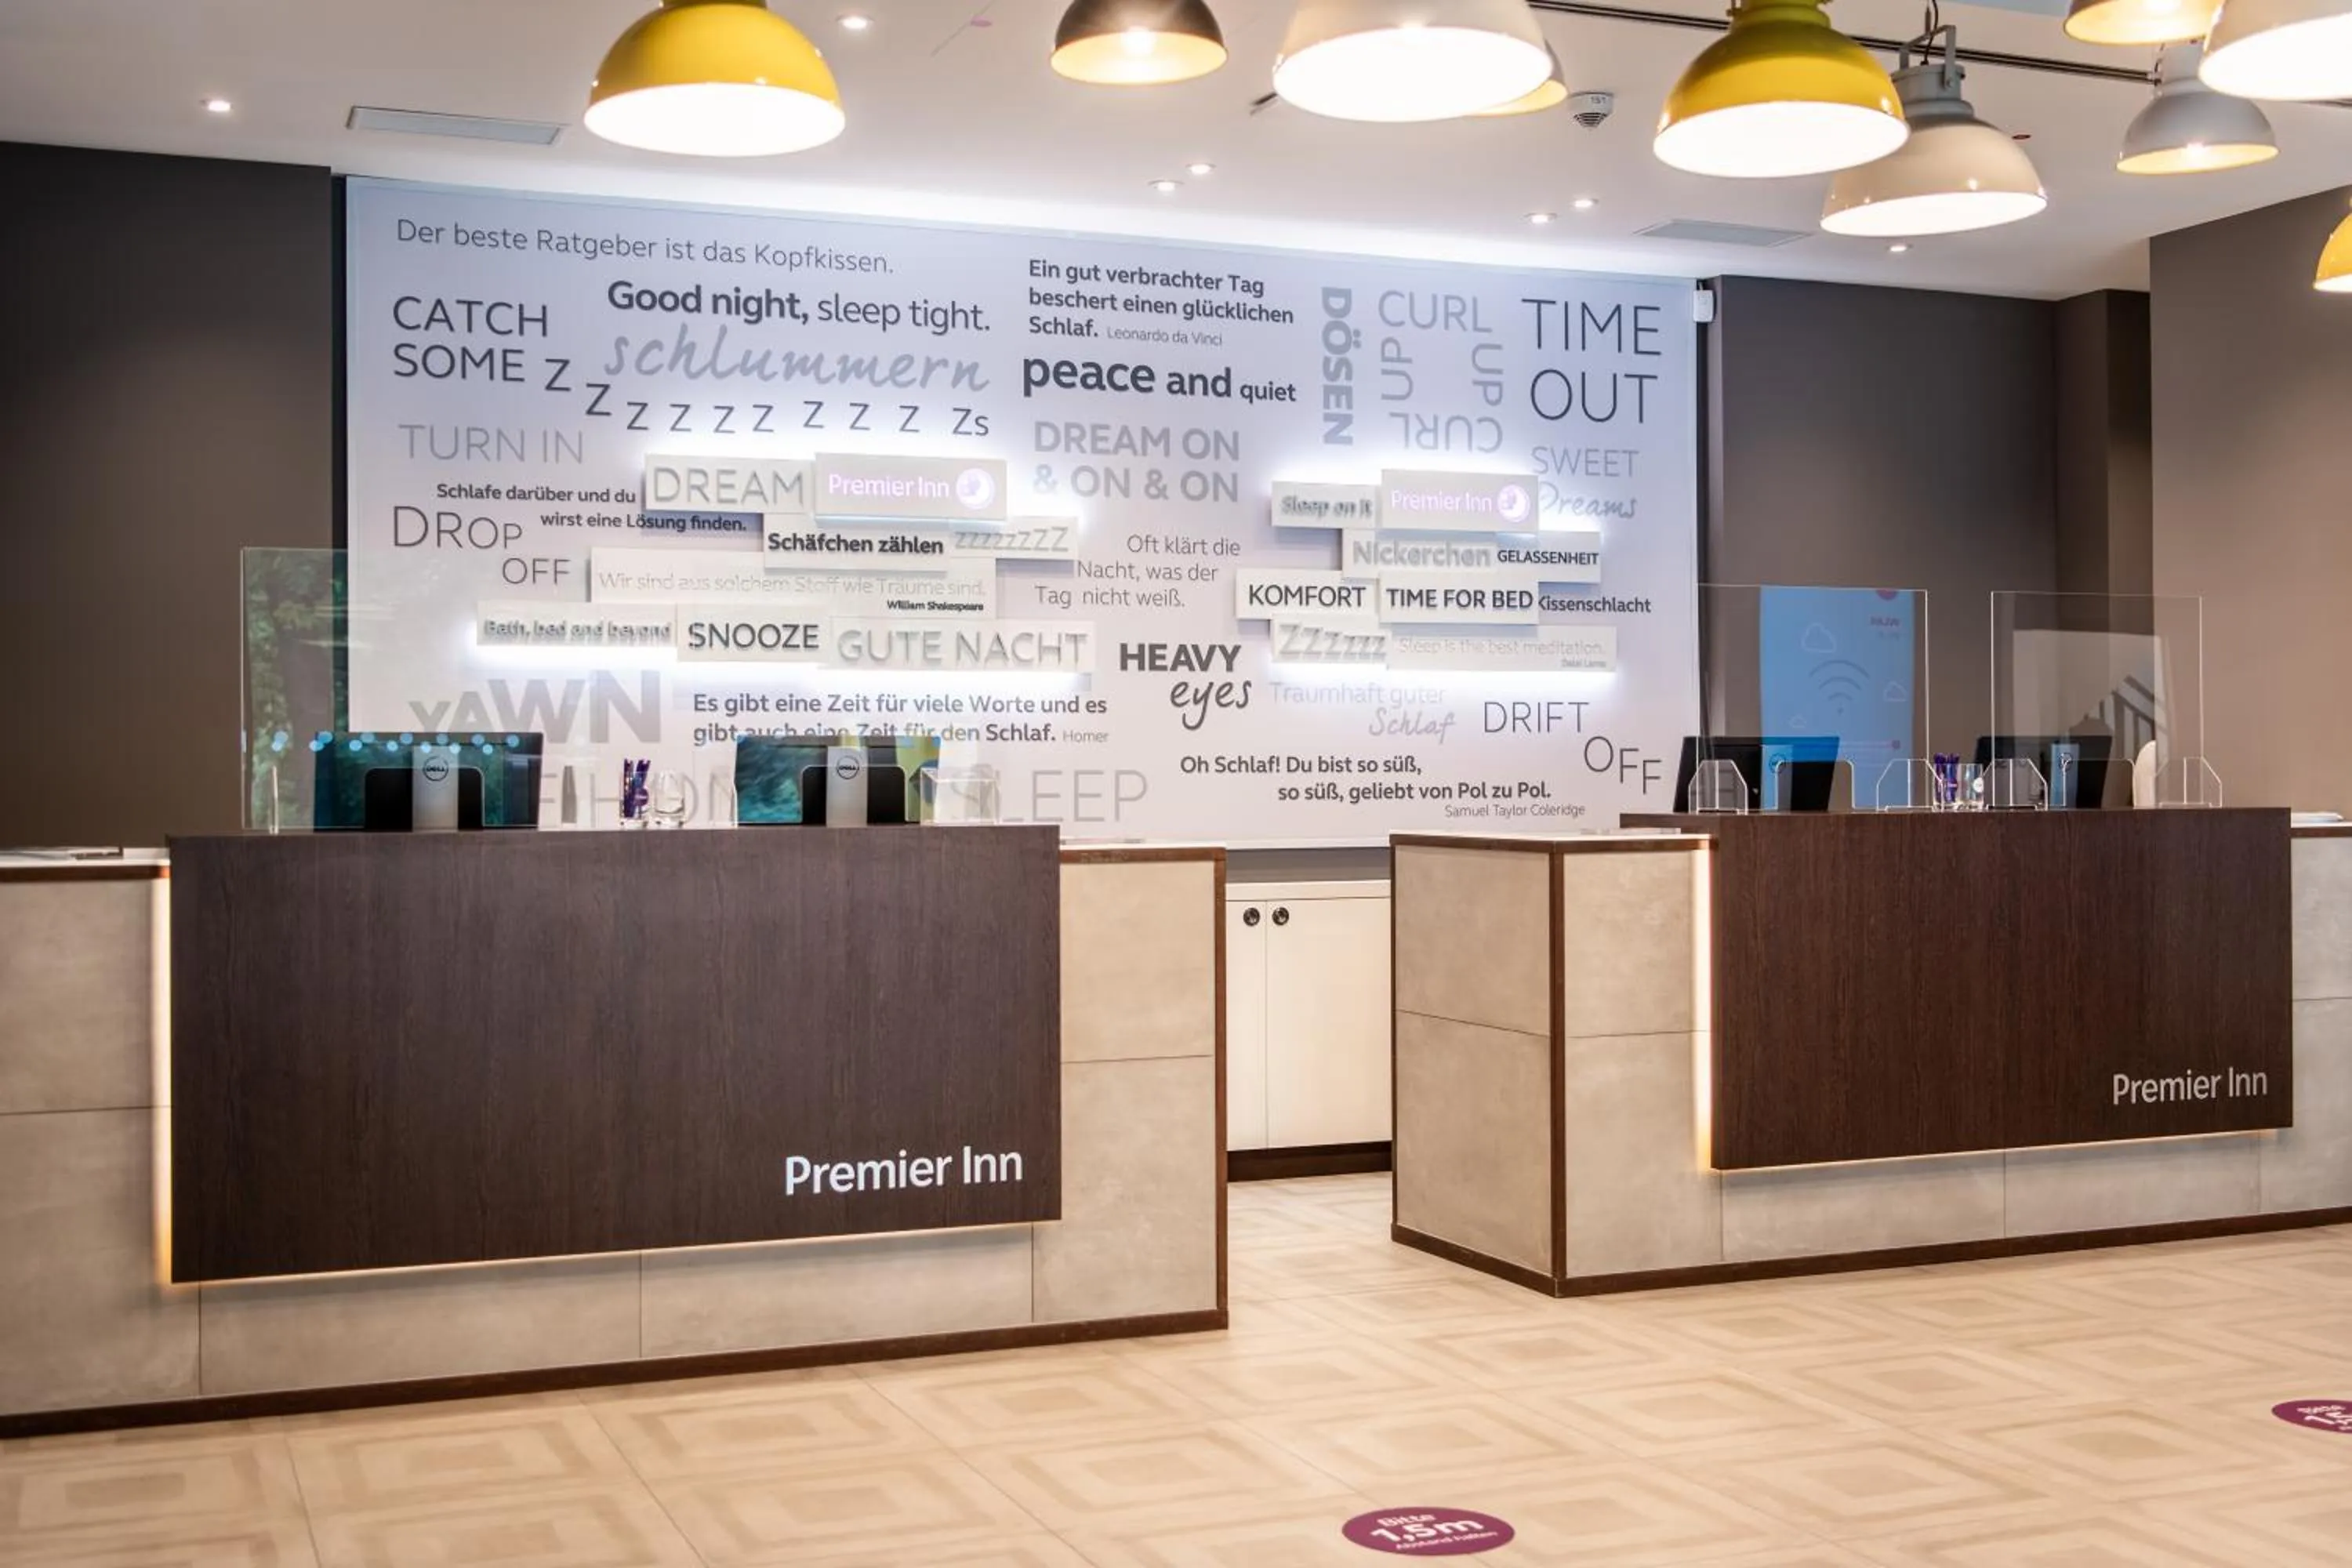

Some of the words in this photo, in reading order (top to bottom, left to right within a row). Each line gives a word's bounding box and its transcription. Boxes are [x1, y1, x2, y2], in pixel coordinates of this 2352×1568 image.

[398, 219, 445, 243] Der
[455, 223, 527, 250] beste
[538, 230, 657, 260] Ratgeber
[666, 238, 694, 260] ist
[704, 240, 745, 263] das
[755, 243, 894, 274] Kopfkissen.
[1029, 260, 1060, 278] Ein
[1066, 264, 1101, 284] gut
[1106, 267, 1221, 290] verbrachter
[1228, 275, 1265, 298] Tag
[394, 296, 547, 336] CATCH
[608, 280, 701, 313] Good
[713, 287, 808, 325] night,
[818, 293, 900, 332] sleep
[909, 299, 991, 335] tight.
[1029, 288, 1117, 310] beschert
[1123, 295, 1176, 314] einen
[1182, 299, 1294, 324] glücklichen
[1378, 290, 1492, 332] CURL
[1029, 316, 1098, 337] Schlaf.
[1108, 327, 1168, 342] Leonardo
[1173, 332, 1188, 344] da
[1191, 332, 1222, 347] Vinci
[1522, 299, 1661, 355] TIME
[604, 322, 990, 392] schlummern
[1321, 287, 1361, 445] DÖSEN
[1381, 337, 1414, 401] UP
[394, 343, 525, 382] SOME
[545, 359, 572, 391] Z
[585, 383, 612, 416] Z
[1024, 358, 1155, 397] peace
[1167, 368, 1232, 397] and
[1240, 381, 1296, 404] quiet
[1472, 343, 1503, 406] UP
[1530, 369, 1657, 423] OUT
[399, 425, 525, 462] TURN
[543, 430, 583, 463] IN
[1034, 421, 1171, 457] DREAM
[1182, 428, 1240, 461] ON
[1389, 412, 1503, 452] CURL
[1531, 445, 1639, 477] SWEET
[437, 483, 502, 499] Schlafe
[506, 485, 572, 502] darüber
[578, 488, 609, 503] und
[614, 489, 636, 503] du
[653, 466, 803, 506] DREAM
[828, 474, 913, 498] Premier
[917, 477, 949, 499] Inn
[1033, 463, 1056, 495] &
[1070, 466, 1130, 499] ON
[1145, 469, 1168, 500] &
[1180, 471, 1238, 503] ON
[1391, 489, 1461, 510] Premier
[1465, 494, 1492, 511] Inn
[1539, 481, 1636, 518] Dreams
[394, 506, 523, 550] DROP
[540, 513, 582, 527] wirst
[587, 514, 622, 528] eine
[626, 514, 686, 531] Lösung
[690, 515, 746, 531] finden.
[768, 533, 873, 553] Schäfchen
[878, 535, 944, 554] zählen
[1127, 534, 1160, 553] Oft
[1164, 537, 1208, 555] klärt
[1212, 539, 1240, 557] die
[1352, 541, 1489, 567] Nickerchen
[1497, 550, 1599, 565] GELASSENHEIT
[502, 557, 571, 585] OFF
[599, 572, 631, 588] Wir
[637, 573, 673, 590] sind
[679, 577, 710, 590] aus
[795, 577, 839, 593] Stoff
[843, 579, 873, 594] wie
[1077, 561, 1139, 582] Nacht,
[1145, 565, 1182, 581] was
[1188, 563, 1218, 581] der
[887, 600, 925, 611] William
[1034, 586, 1071, 608] Tag
[1083, 587, 1131, 607] nicht
[1136, 589, 1185, 608] weiß.
[1249, 584, 1367, 608] KOMFORT
[1386, 588, 1437, 608] TIME
[1443, 590, 1485, 609] FOR
[1492, 590, 1533, 610] BED
[688, 623, 819, 650] SNOOZE
[837, 630, 942, 662] GUTE
[956, 632, 1087, 666] NACHT
[1399, 638, 1441, 654] Sleep
[1459, 639, 1484, 654] the
[1489, 639, 1519, 655] best
[1120, 643, 1241, 672] HEAVY
[409, 670, 661, 744] YAWN
[694, 694, 718, 712] Es
[725, 694, 769, 717] gibt
[775, 694, 821, 712] eine
[828, 694, 870, 712] Zeit
[877, 694, 906, 712] für
[913, 695, 964, 713] viele
[969, 695, 1035, 713] Worte
[1041, 695, 1080, 713] und
[1086, 699, 1107, 713] es
[1171, 681, 1252, 731] eyes
[1269, 681, 1384, 703] Traumhaft
[1390, 688, 1445, 709] guter
[1369, 707, 1455, 744] Schlaf
[1485, 702, 1589, 733] DRIFT
[694, 723, 737, 746] gibt
[941, 724, 980, 741] den
[986, 724, 1055, 742] Schlaf.
[1063, 731, 1109, 742] Homer
[1181, 756, 1209, 773] Oh
[1214, 756, 1280, 773] Schlaf!
[1287, 757, 1312, 773] Du
[1319, 756, 1352, 772] bist
[1357, 760, 1377, 772] so
[1383, 756, 1421, 775] süß,
[1584, 736, 1662, 795] OFF
[1279, 787, 1299, 800] so
[1305, 782, 1343, 802] süß,
[1349, 783, 1414, 804] geliebt
[1419, 786, 1452, 799] von
[1458, 782, 1486, 799] Pol
[1492, 786, 1512, 798] zu
[1518, 782, 1551, 799] Pol.
[1445, 804, 1488, 817] Samuel
[1492, 804, 1526, 818] Taylor
[1530, 804, 1585, 817] Coleridge
[2114, 1069, 2222, 1105] Premier
[2229, 1067, 2267, 1098] Inn
[786, 1149, 952, 1195] Premier
[964, 1145, 1022, 1184] Inn
[1370, 1520, 1484, 1542] 1,5m
[1377, 1515, 1436, 1526] Bitte
